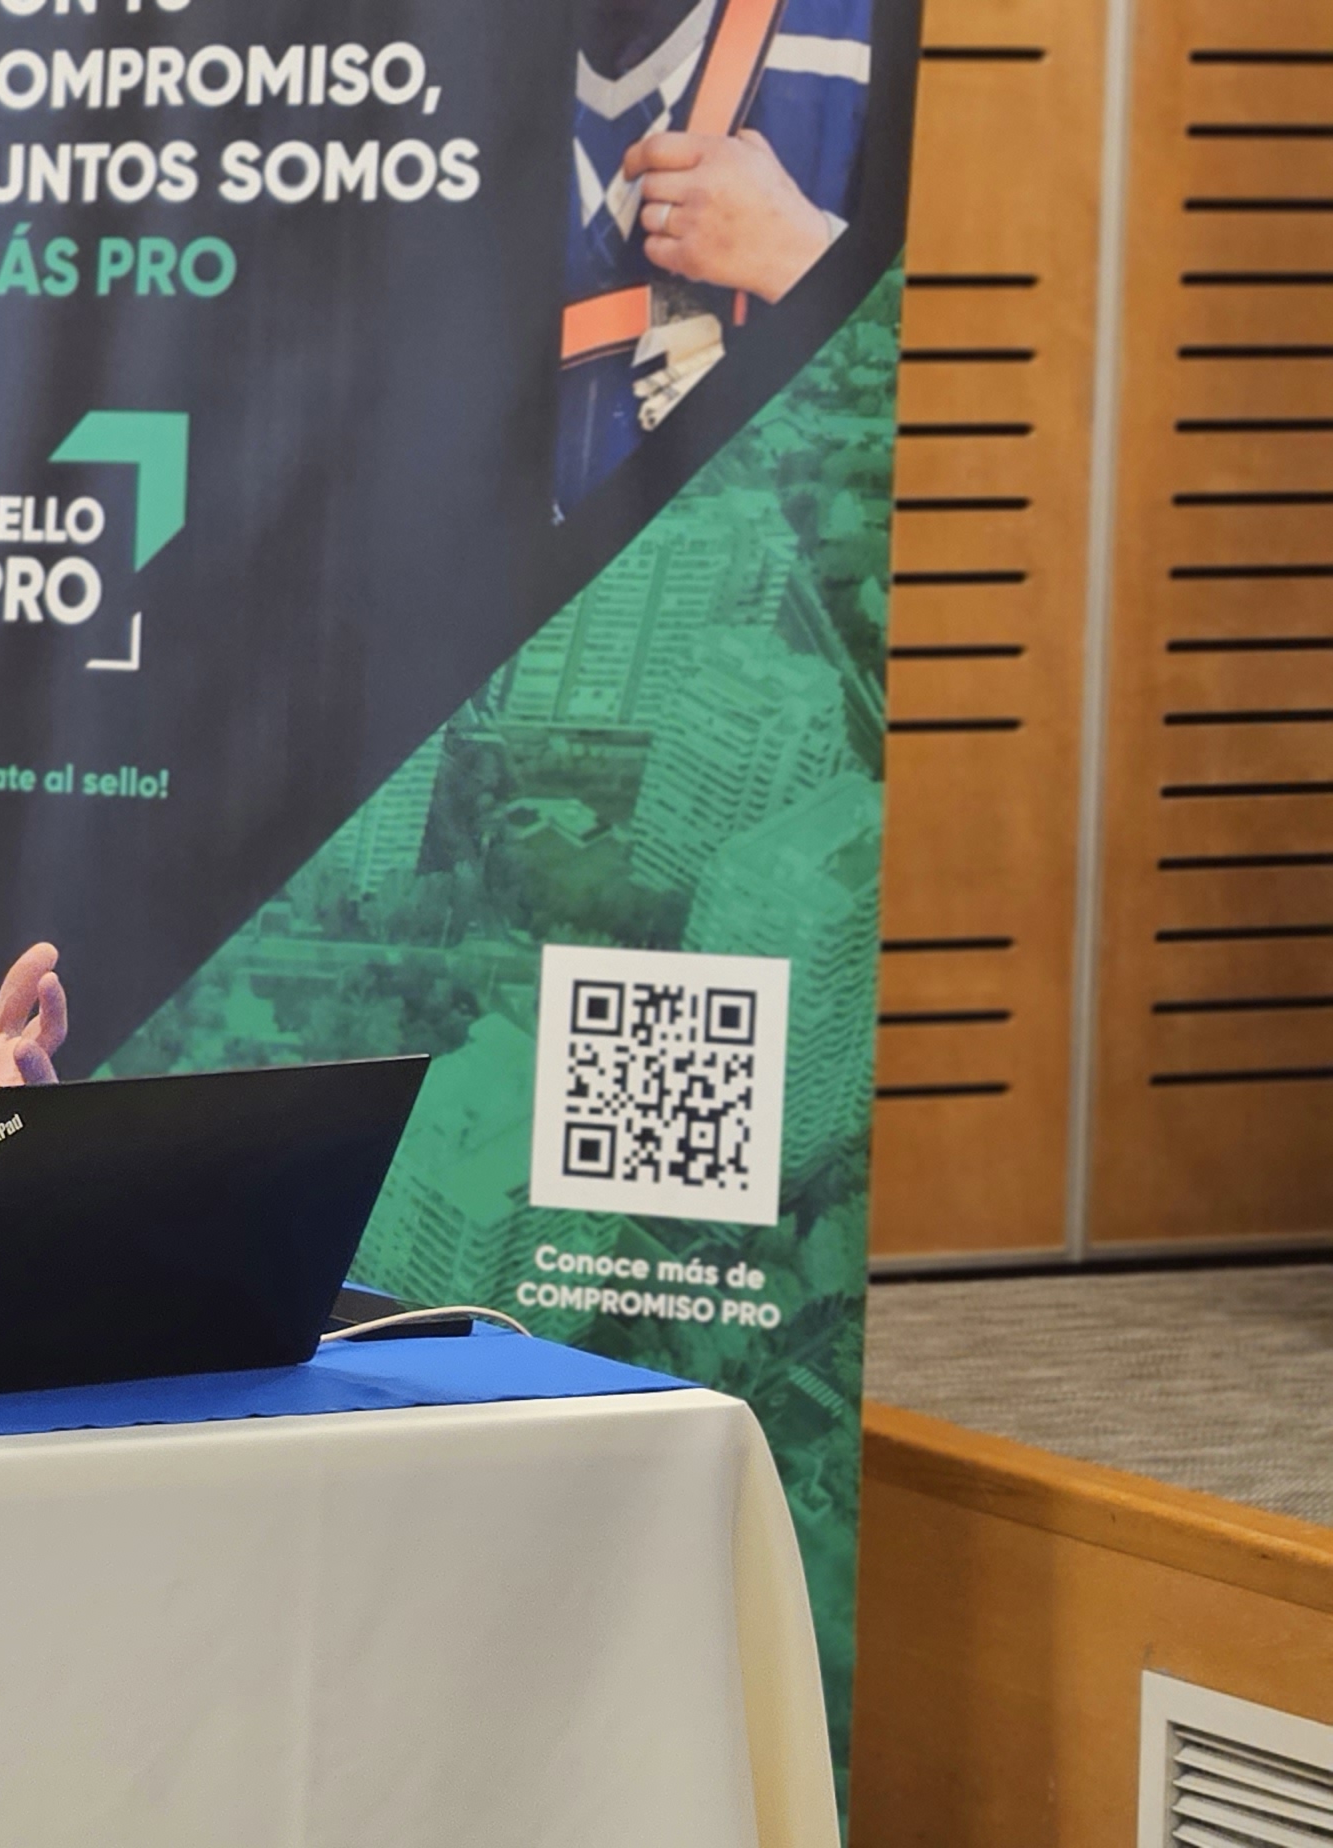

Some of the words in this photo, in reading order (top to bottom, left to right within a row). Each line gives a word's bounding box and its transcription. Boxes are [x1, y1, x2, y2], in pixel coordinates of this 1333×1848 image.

[218, 138, 481, 203] SOMOS
[96, 236, 237, 297] PRO
[43, 764, 74, 794] al
[82, 766, 170, 799] sello!
[535, 1244, 650, 1279] Conoce
[657, 1257, 719, 1286] más
[726, 1262, 766, 1290] de
[517, 1282, 716, 1323] COMPROMISO
[721, 1300, 782, 1329] PRO
